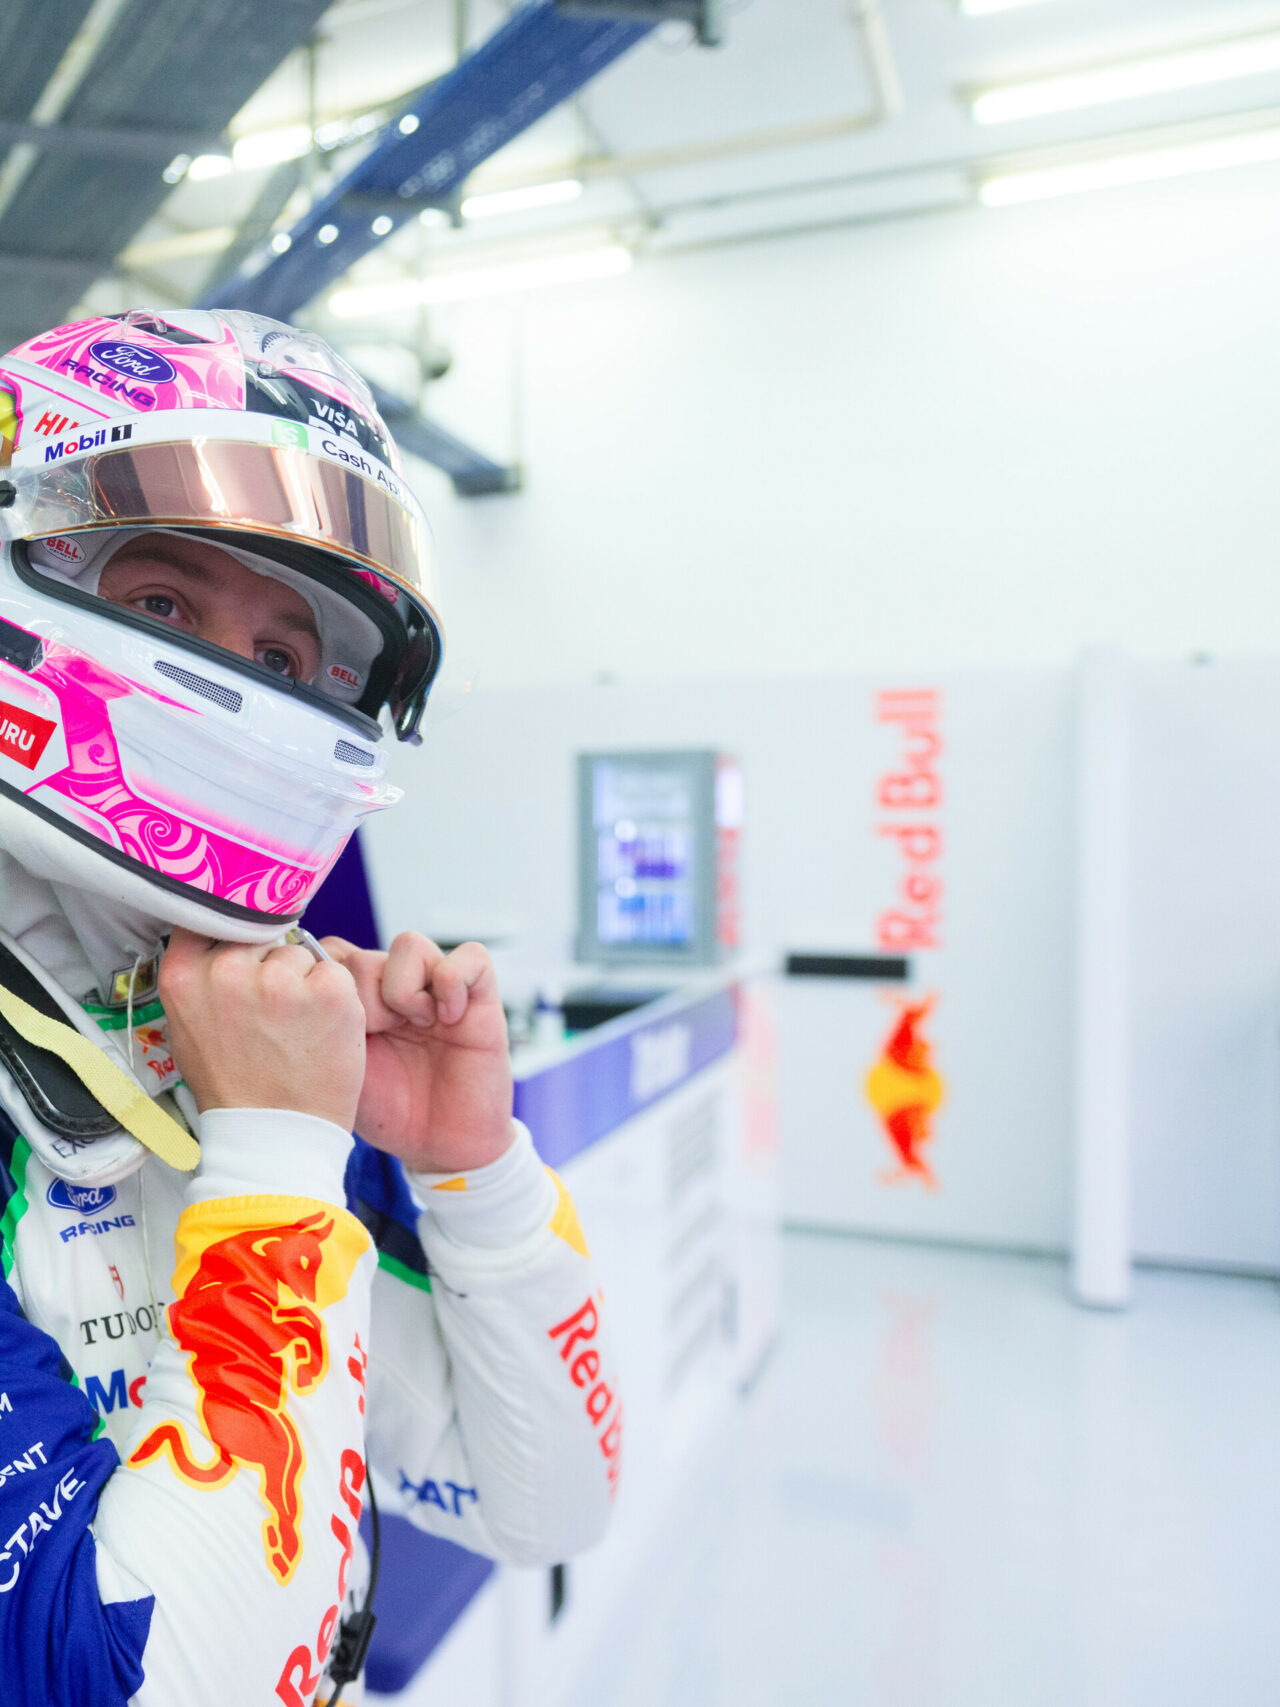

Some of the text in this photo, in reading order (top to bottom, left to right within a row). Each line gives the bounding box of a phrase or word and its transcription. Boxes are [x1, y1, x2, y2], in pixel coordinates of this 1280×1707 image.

[100, 345, 161, 376] Ford
[60, 358, 156, 407] RACING
[310, 398, 359, 437] VISA
[44, 428, 106, 463] Mobil
[321, 440, 401, 495] Cash Ap
[46, 537, 79, 559] BELL
[330, 665, 359, 687] BELL
[875, 690, 942, 952] Red Bull
